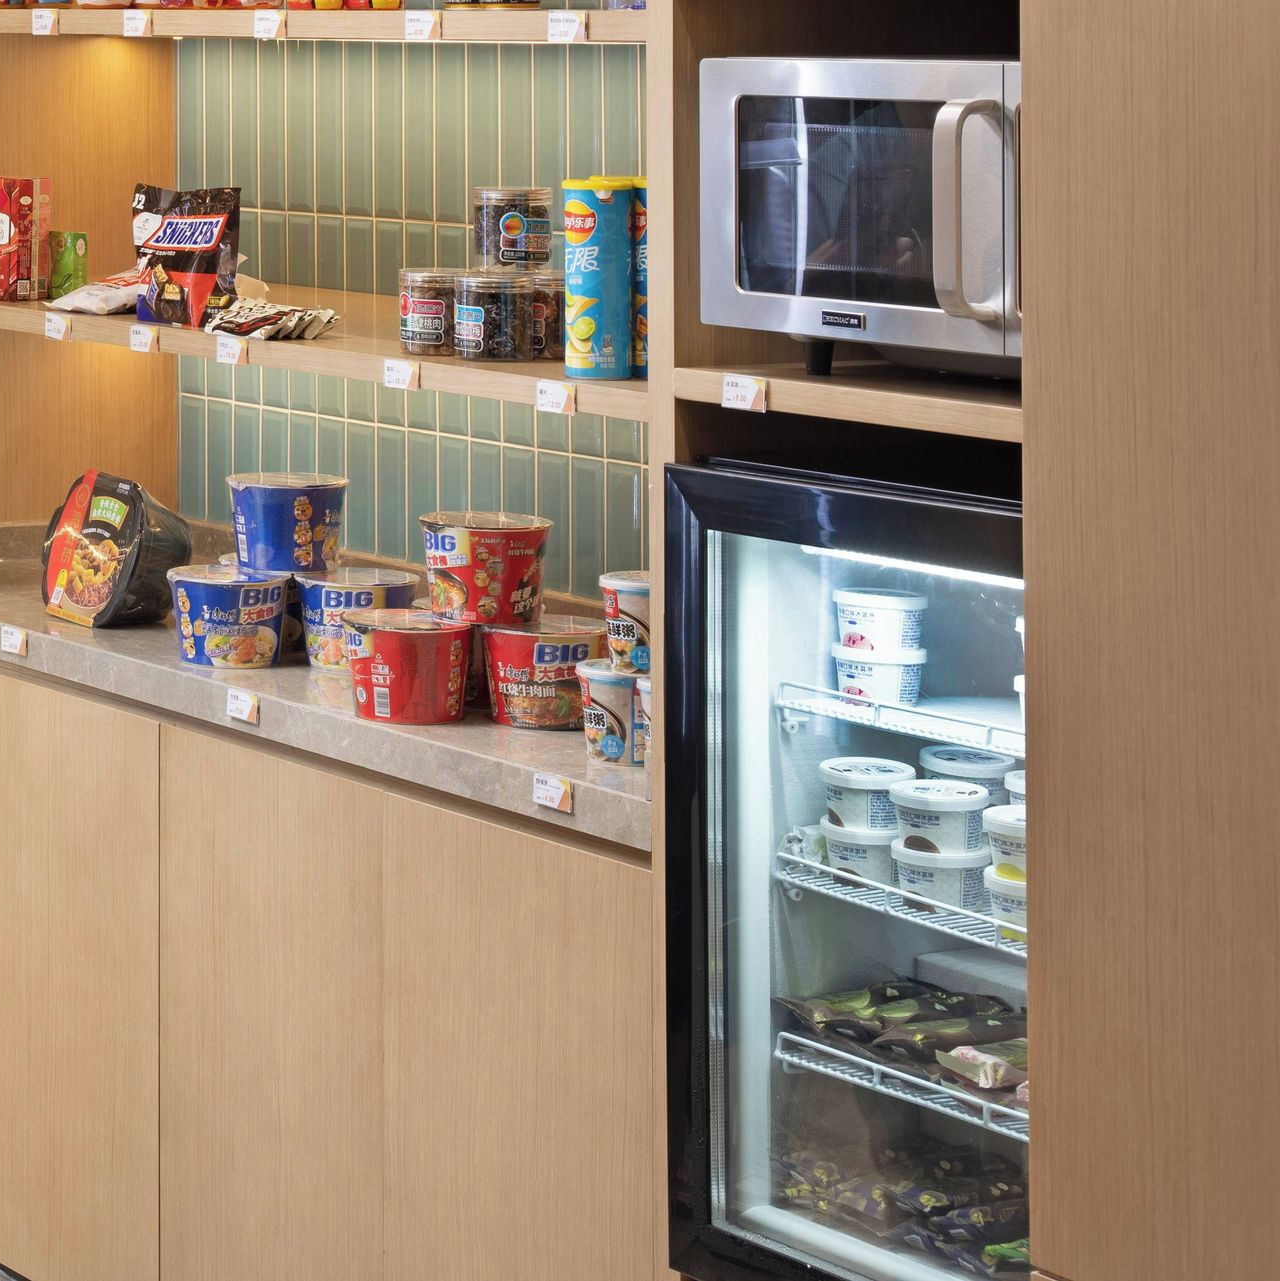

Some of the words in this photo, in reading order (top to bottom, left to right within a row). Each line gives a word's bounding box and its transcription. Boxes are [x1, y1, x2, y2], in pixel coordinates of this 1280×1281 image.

[155, 220, 220, 247] SNICKERS
[424, 530, 457, 553] BIG
[241, 586, 282, 608] BIG
[323, 589, 374, 609] BIG
[534, 642, 589, 666] BIG
[497, 682, 556, 698] 红烧牛肉面
